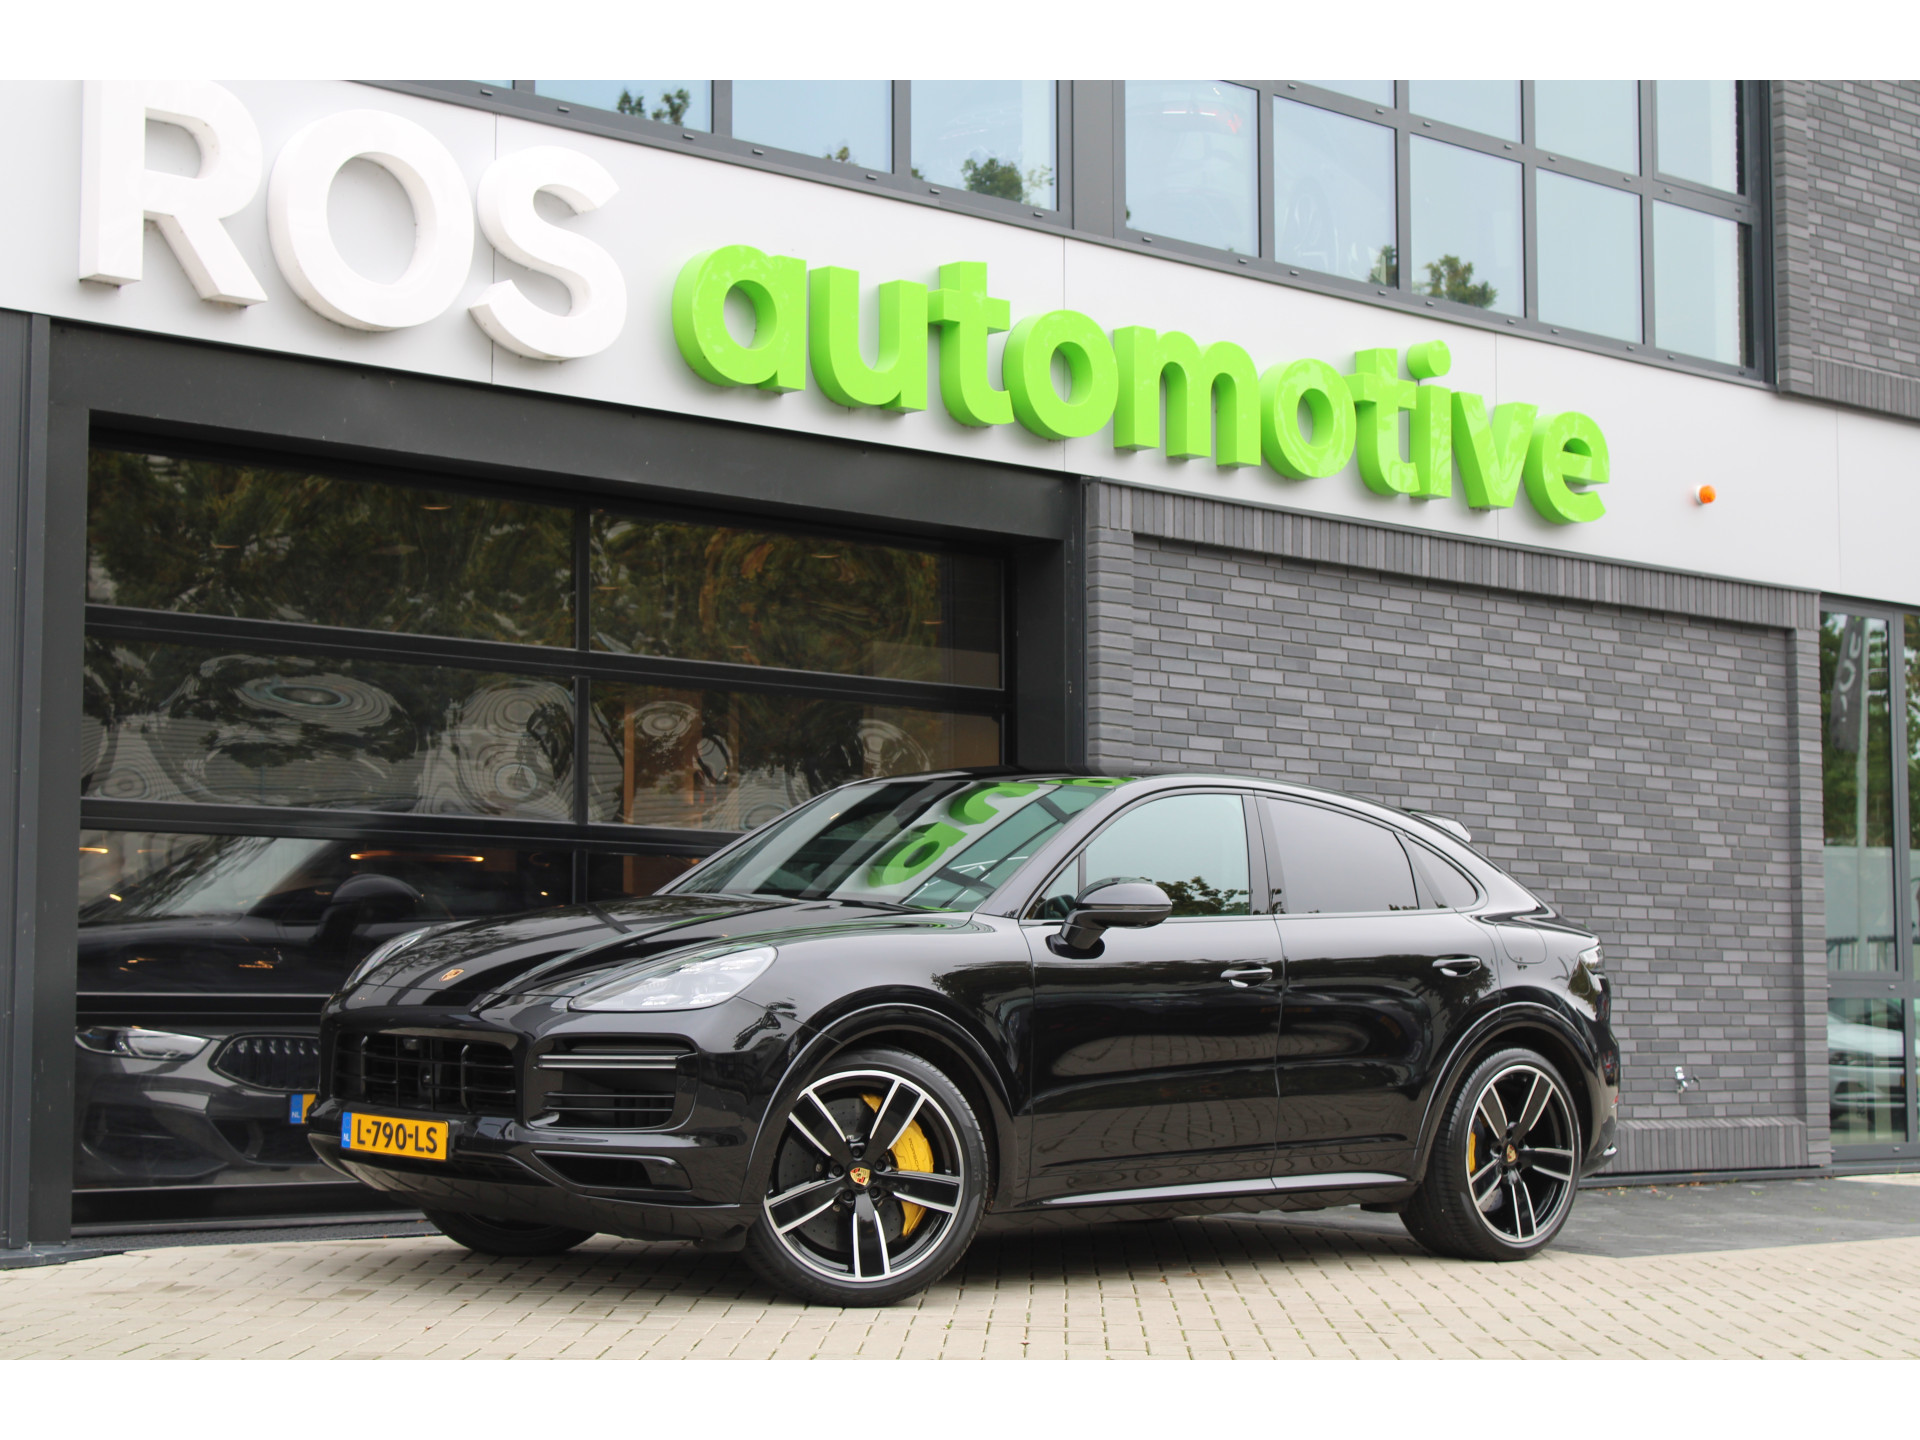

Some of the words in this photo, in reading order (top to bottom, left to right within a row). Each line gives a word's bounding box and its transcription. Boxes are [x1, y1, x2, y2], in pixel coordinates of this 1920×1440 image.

[79, 81, 627, 361] ROS
[672, 244, 1610, 524] automotive
[291, 1111, 301, 1119] NL
[357, 1119, 438, 1154] L-790-LS
